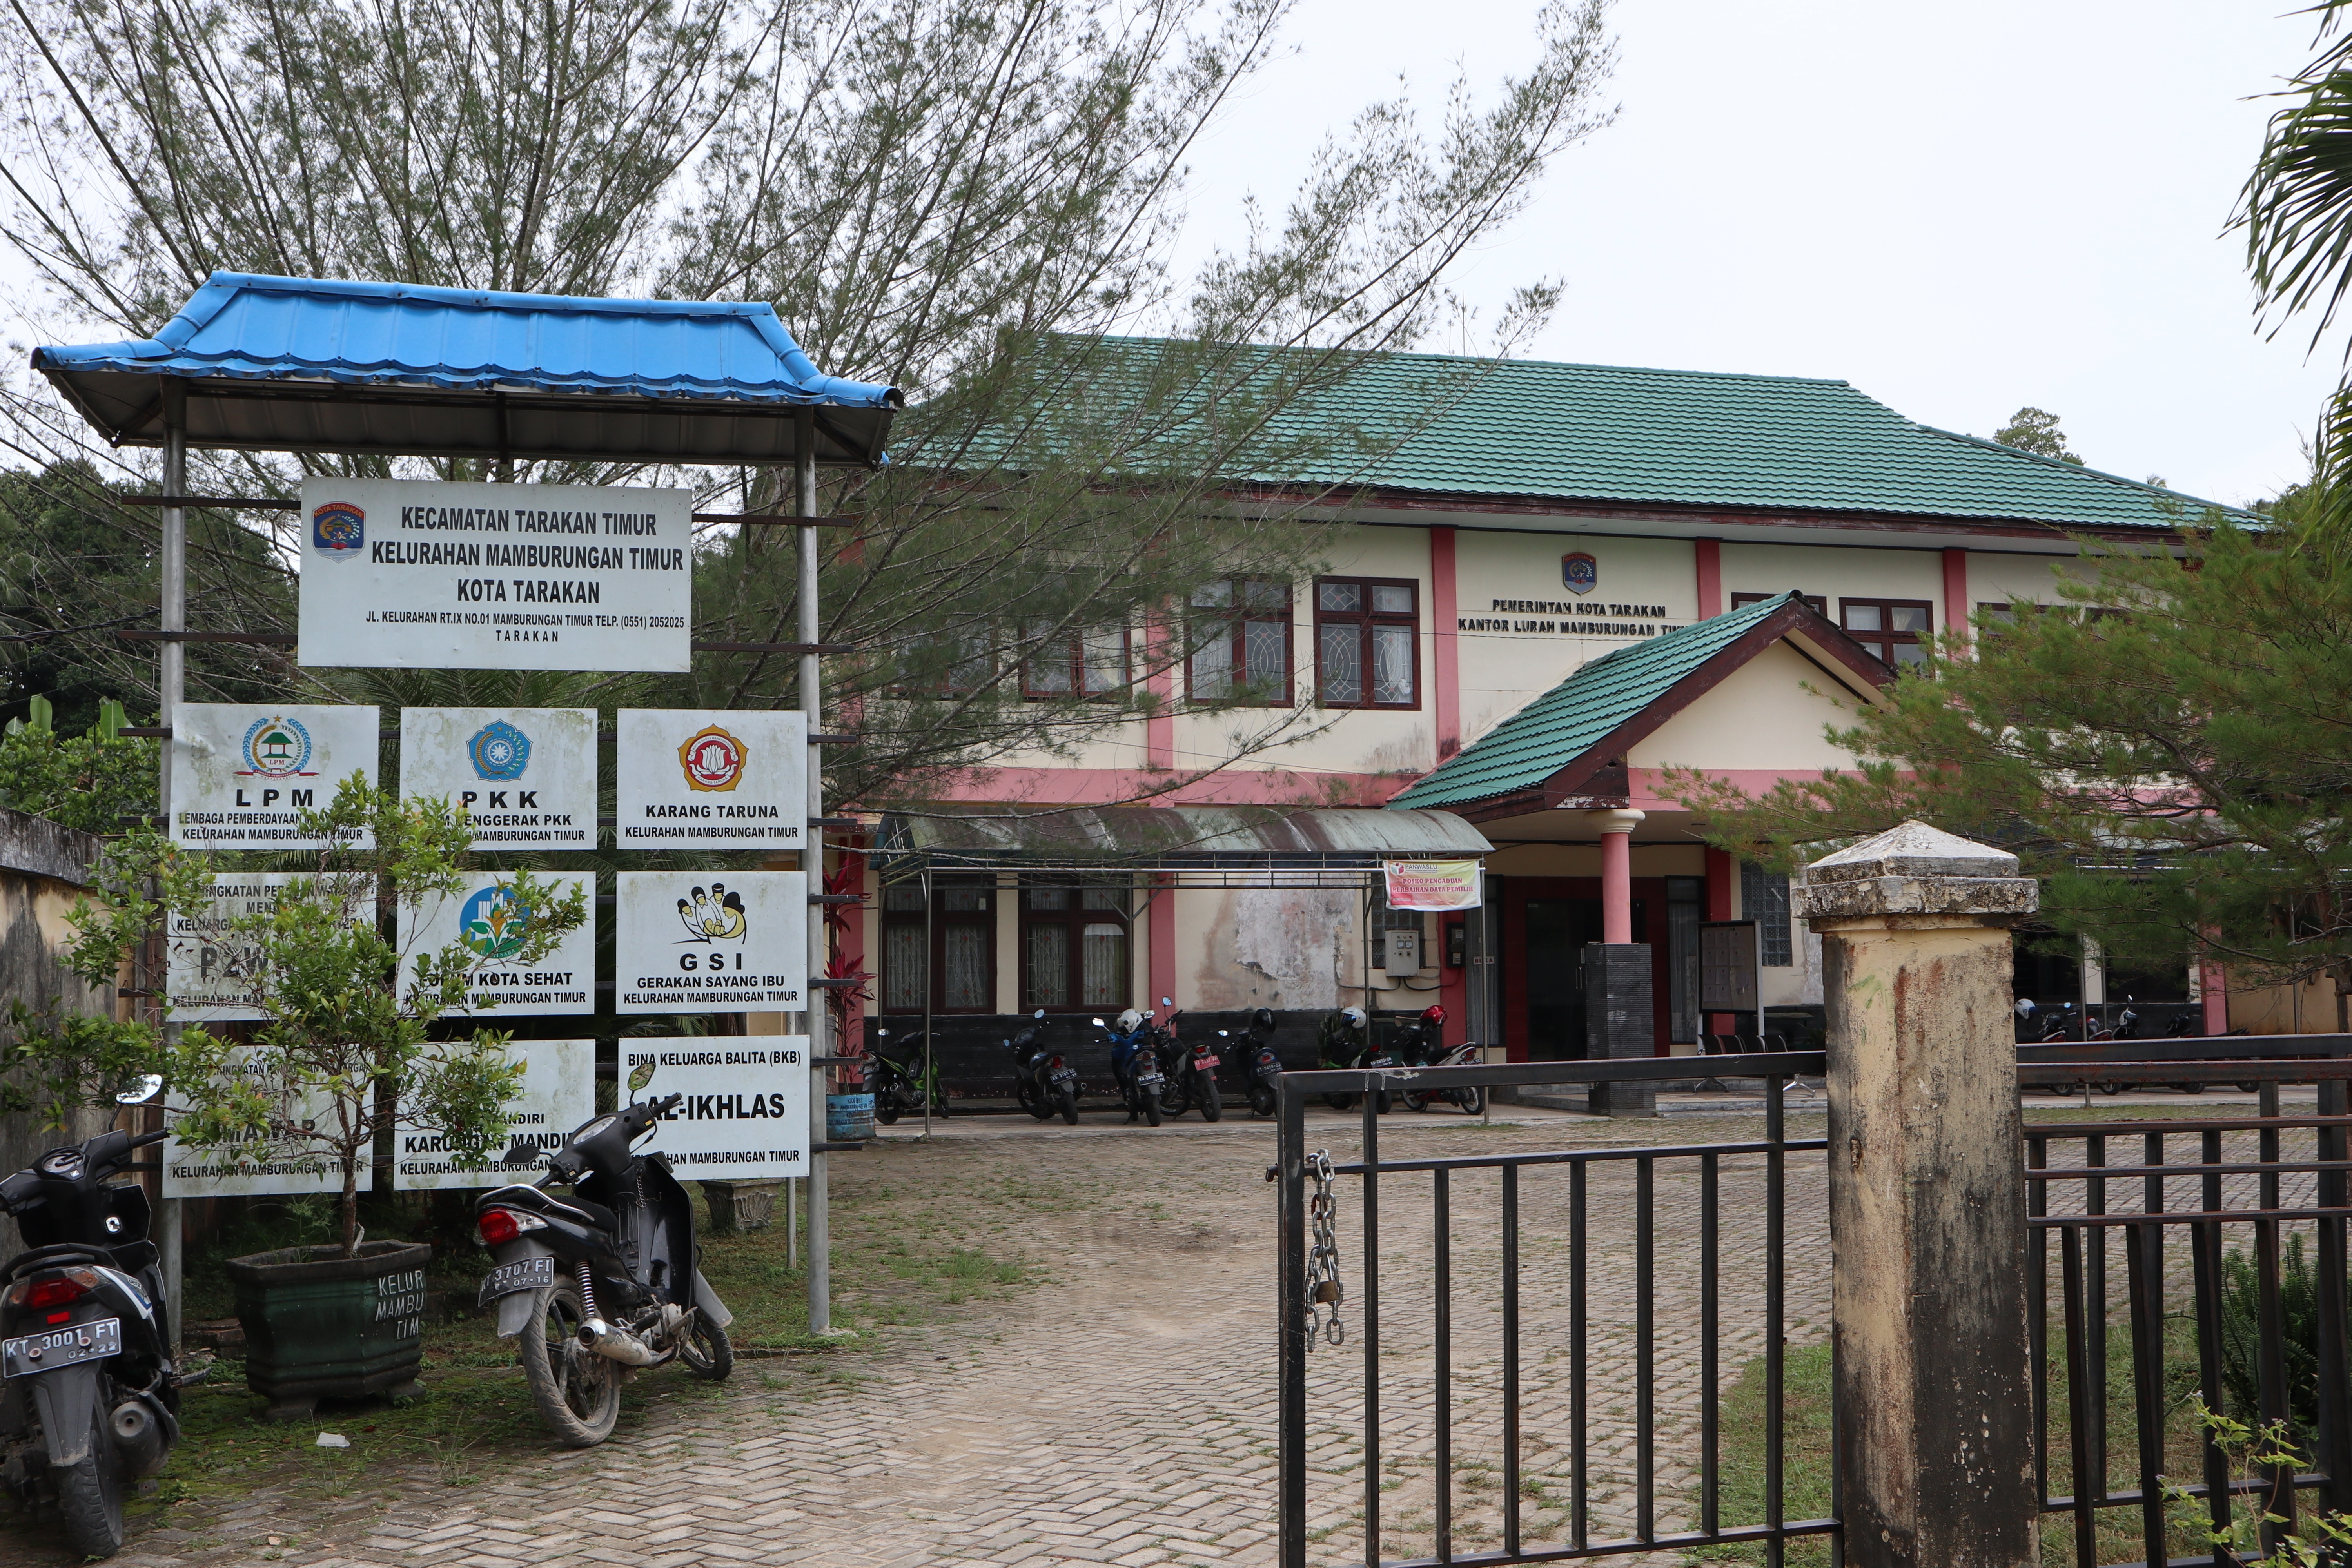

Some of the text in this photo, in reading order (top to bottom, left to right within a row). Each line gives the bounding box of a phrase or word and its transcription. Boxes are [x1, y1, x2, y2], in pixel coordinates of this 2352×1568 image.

[314, 505, 363, 517] KOTA TARAKAN
[401, 506, 656, 535] KECAMATAN TARAKAN TIMUR
[372, 541, 683, 570] KELURAHAN MAMBURUNGAN TIMUR
[457, 579, 599, 603] KOTA TARAKAN
[1493, 599, 1666, 617] PEMERINTAH KOTA TARAKAN
[366, 611, 684, 630] JL. KELURAHAN RT.IX NO.01 MAMBURUNGAN TIMUR TELP. (0551) 2052025
[1458, 618, 1509, 632] KANTOR
[1515, 620, 1555, 633] LURAH
[1560, 621, 1655, 636] MAMBURUNGAN
[179, 813, 224, 824] LEMBAGA
[227, 813, 301, 824] PEMBERDAYAAN
[646, 805, 779, 818] KARANG TARUNA
[544, 815, 572, 826] PKK
[183, 829, 245, 840] KELURAHAN
[554, 830, 584, 840] TIMUR
[625, 827, 798, 838] KELURAHAN MAMBURUNGAN TIMUR
[479, 973, 519, 986] KOTA
[524, 973, 573, 985] SEHAT
[637, 976, 784, 988] GERAKAN SAYANG IBU
[554, 992, 586, 1003] TIMUR
[624, 991, 797, 1004] KELURAHAN MAMBURUNGAN TIMUR
[628, 1051, 801, 1067] BINA KELUARGA BALITA (BKB)
[648, 1093, 785, 1121] AL-IKHLAS
[690, 1151, 765, 1164] MAMBURUNGAN
[769, 1150, 799, 1161] TIMUR
[379, 1270, 423, 1296] KELUR
[481, 1260, 550, 1292] KT 3707 FI
[375, 1292, 424, 1321] MAMBU
[397, 1316, 419, 1339] TIM
[6, 1321, 117, 1358] KT 3001 FT
